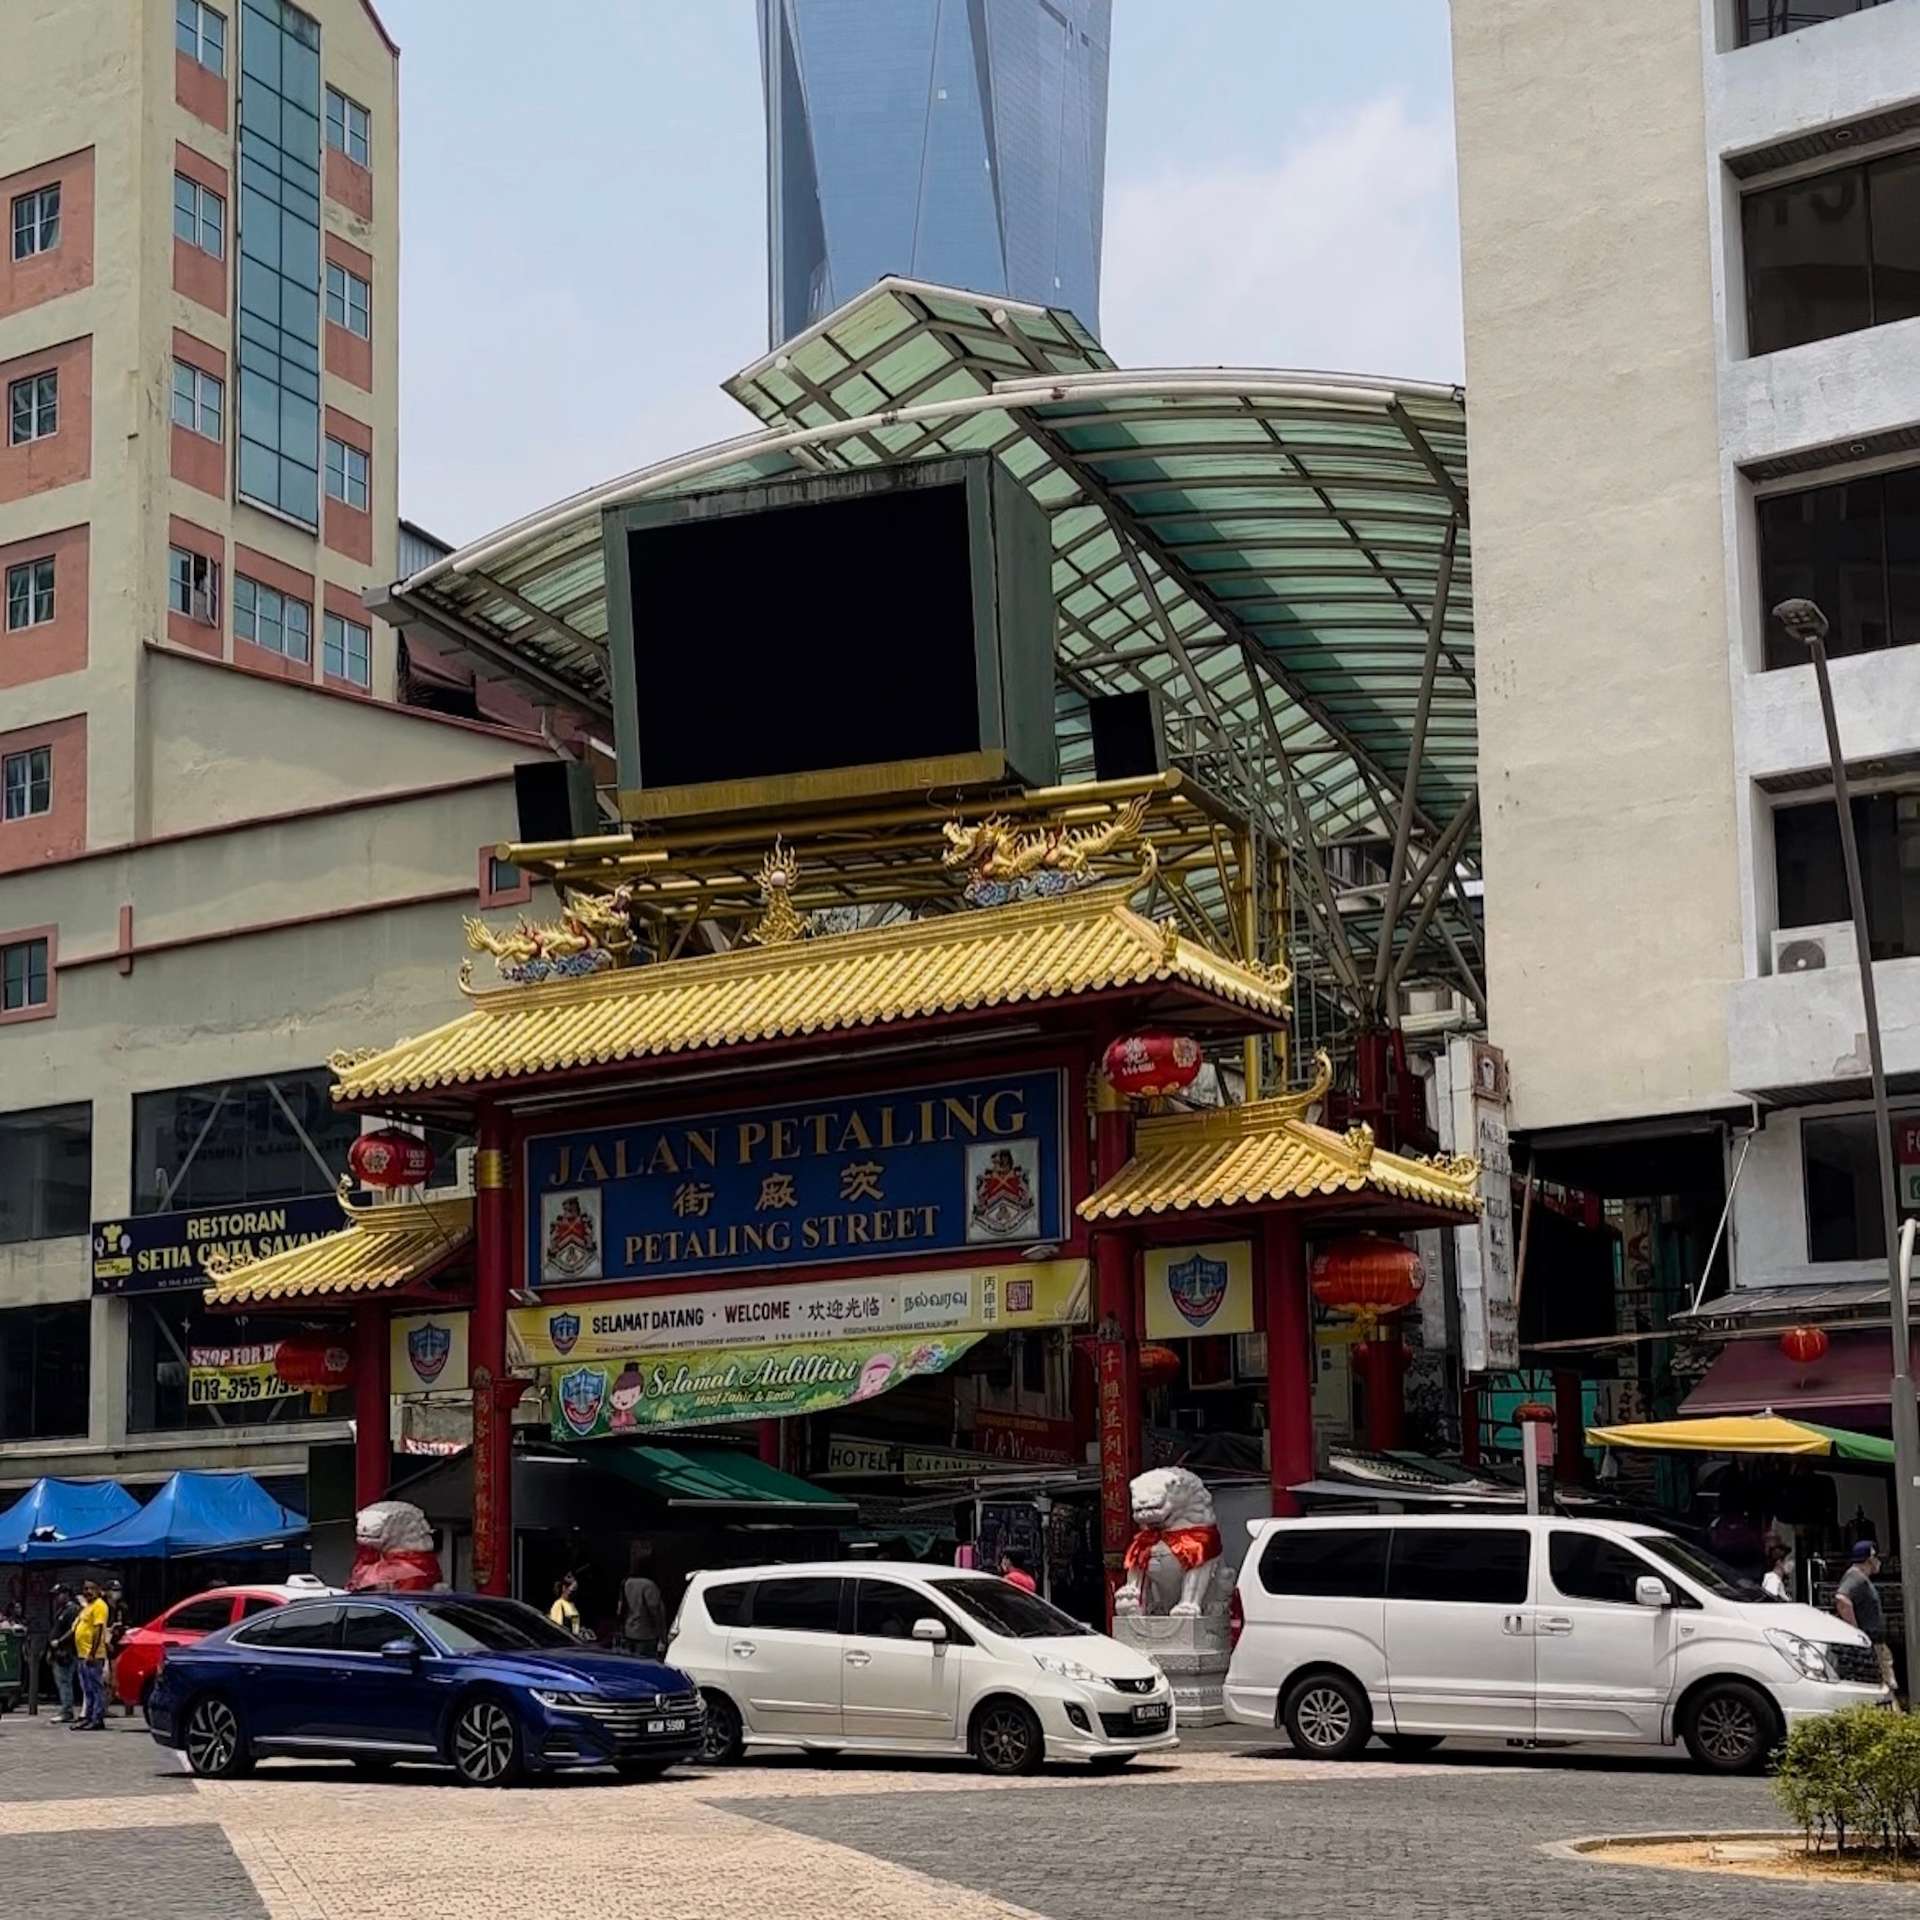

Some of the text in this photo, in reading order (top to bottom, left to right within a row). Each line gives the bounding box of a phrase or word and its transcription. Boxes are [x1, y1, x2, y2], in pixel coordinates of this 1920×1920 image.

[551, 1089, 1028, 1186] JALAN PETALING
[186, 1209, 287, 1240] RESTORAN
[624, 1221, 791, 1266] PETALING
[802, 1205, 940, 1249] STREET
[137, 1246, 192, 1272] SETIA
[592, 1301, 791, 1335] SELAMAT DATANG WELCOME
[807, 1294, 882, 1321] 欢迎光临
[232, 1345, 261, 1364] FOR
[192, 1376, 262, 1401] 013-355
[646, 1353, 858, 1398] Selamat Aidilfitri
[754, 1390, 765, 1403] &
[831, 1447, 885, 1471] HOTEL
